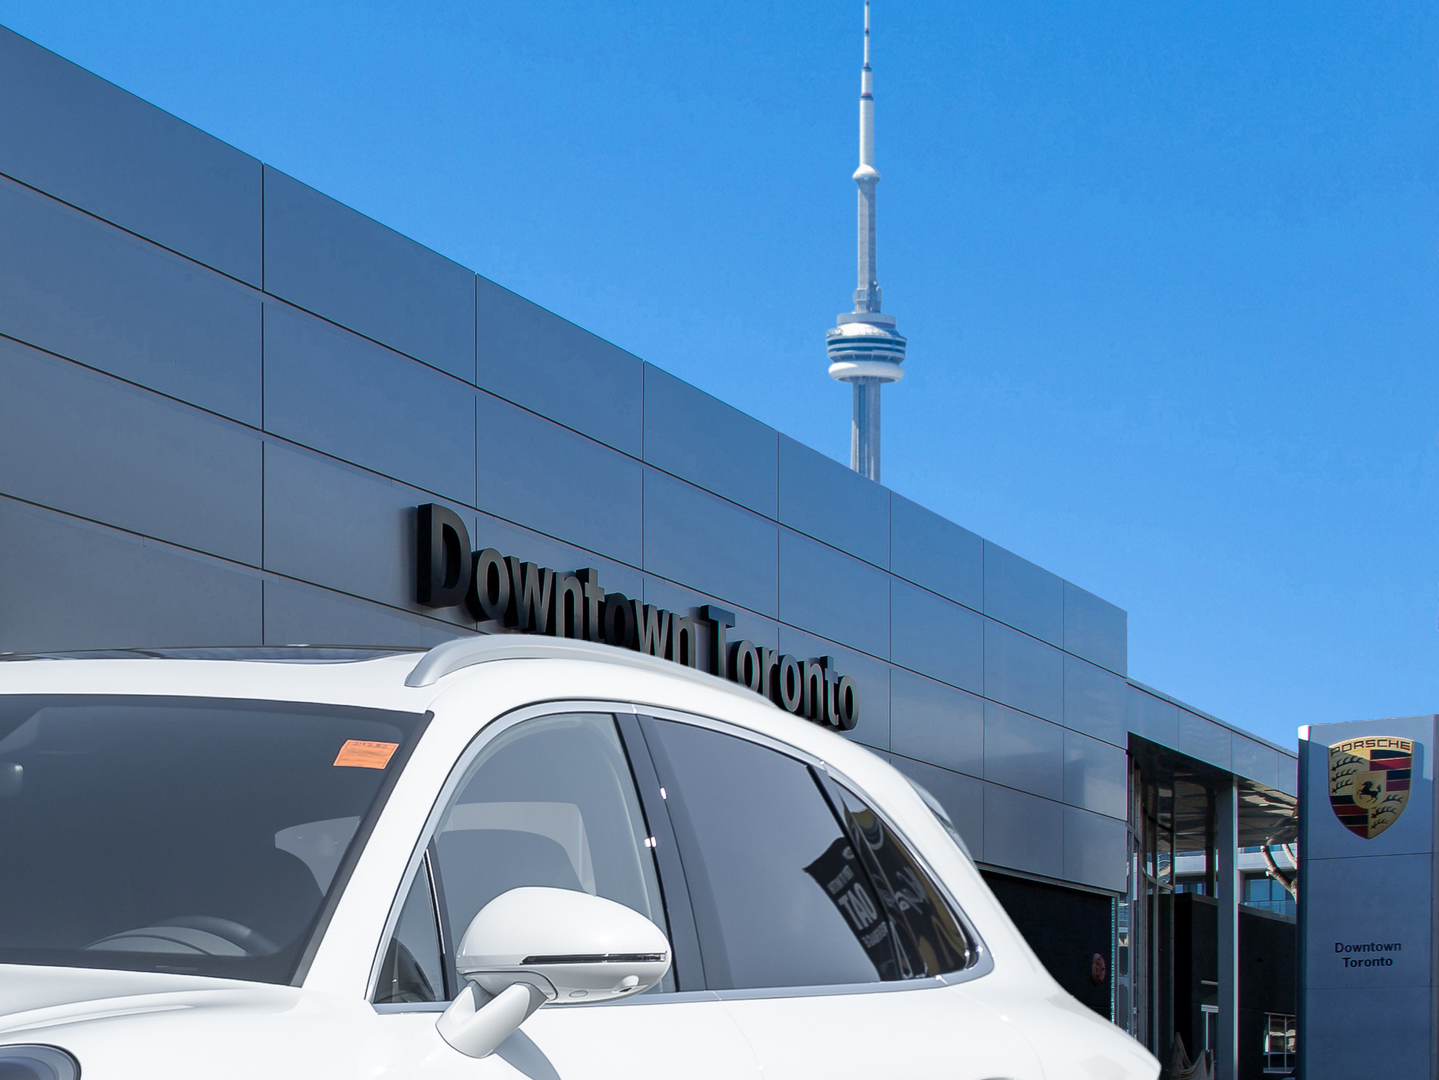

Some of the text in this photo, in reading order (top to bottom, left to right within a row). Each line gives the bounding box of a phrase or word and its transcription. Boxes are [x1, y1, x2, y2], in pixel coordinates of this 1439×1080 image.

[417, 502, 860, 731] Downtown Toronto
[1330, 739, 1411, 757] PORSCHE
[1335, 942, 1402, 954] Downtown
[1342, 957, 1393, 968] Toronto
